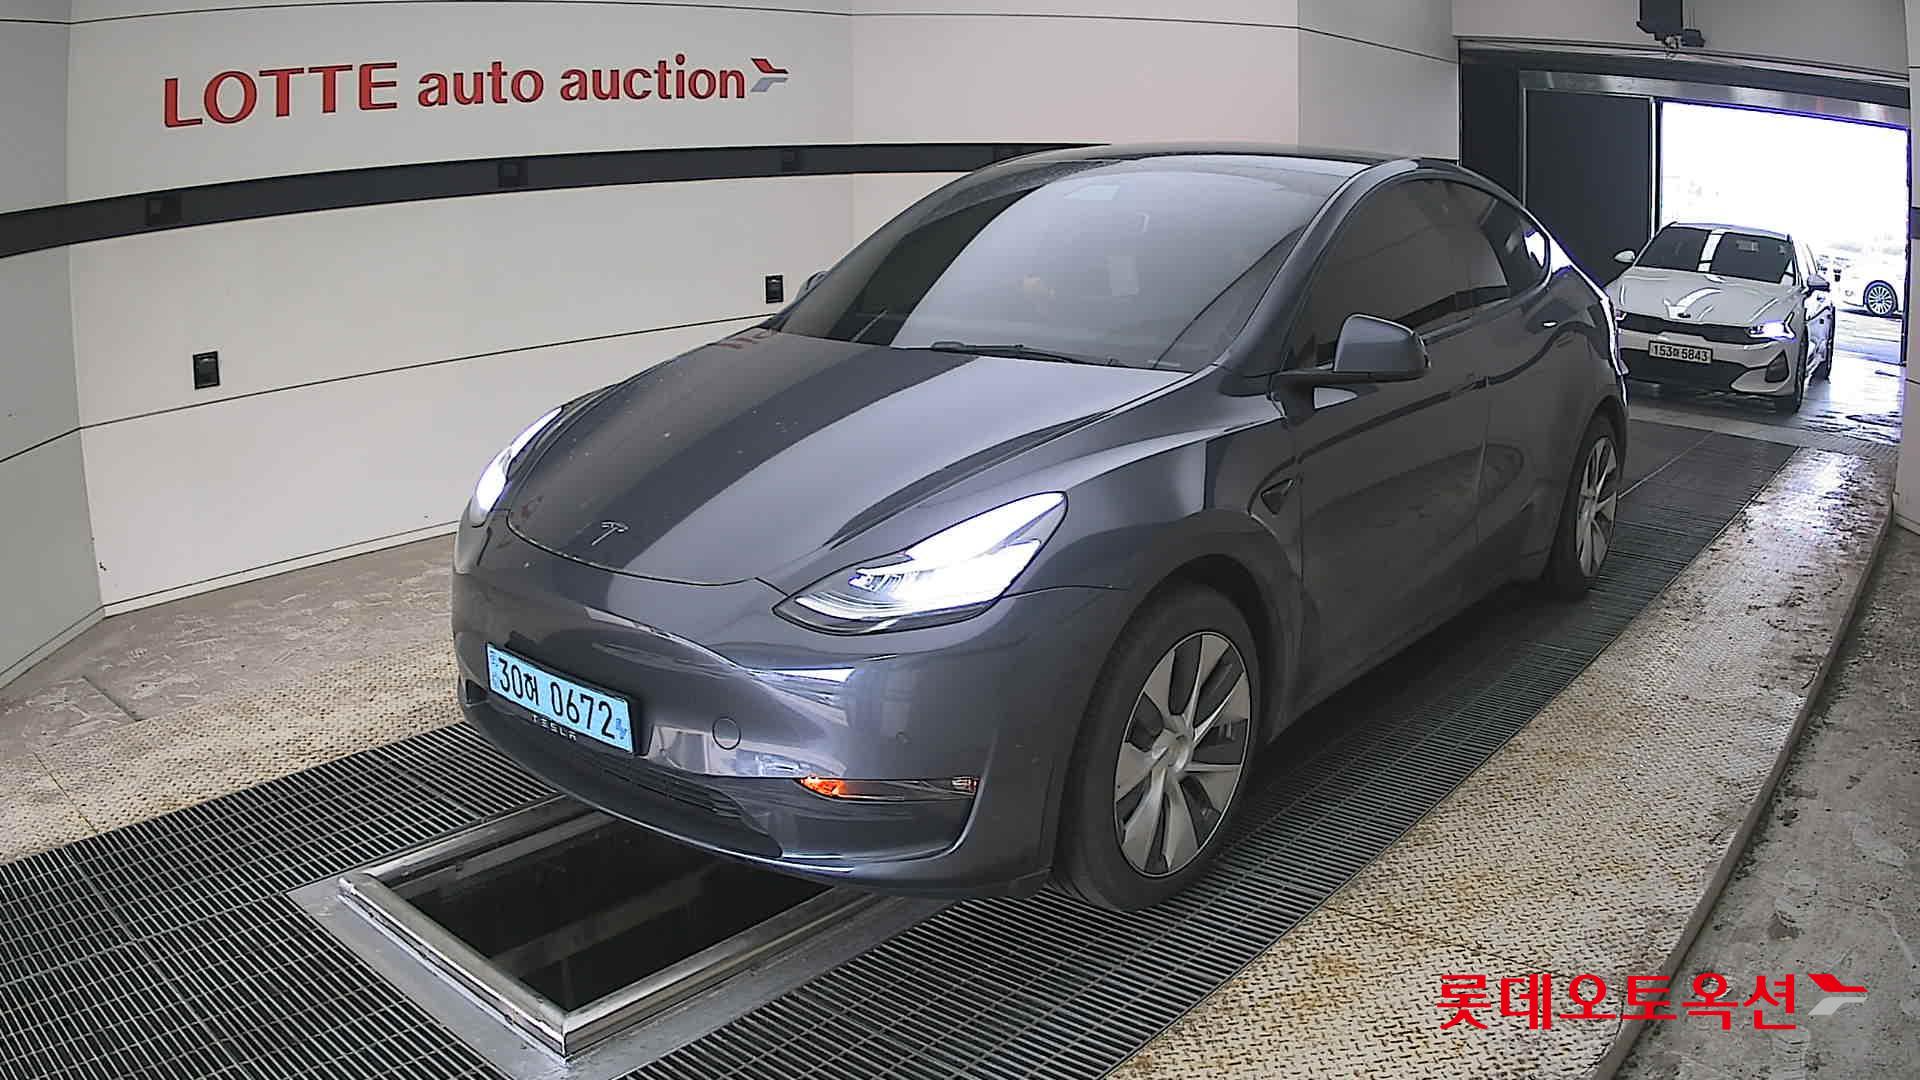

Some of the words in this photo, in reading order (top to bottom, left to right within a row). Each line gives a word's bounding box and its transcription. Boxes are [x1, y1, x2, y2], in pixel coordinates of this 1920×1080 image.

[164, 61, 398, 129] LOTTE
[417, 60, 544, 107] auto
[560, 53, 747, 101] auction
[531, 715, 577, 741] TESLA
[551, 682, 616, 740] 0672
